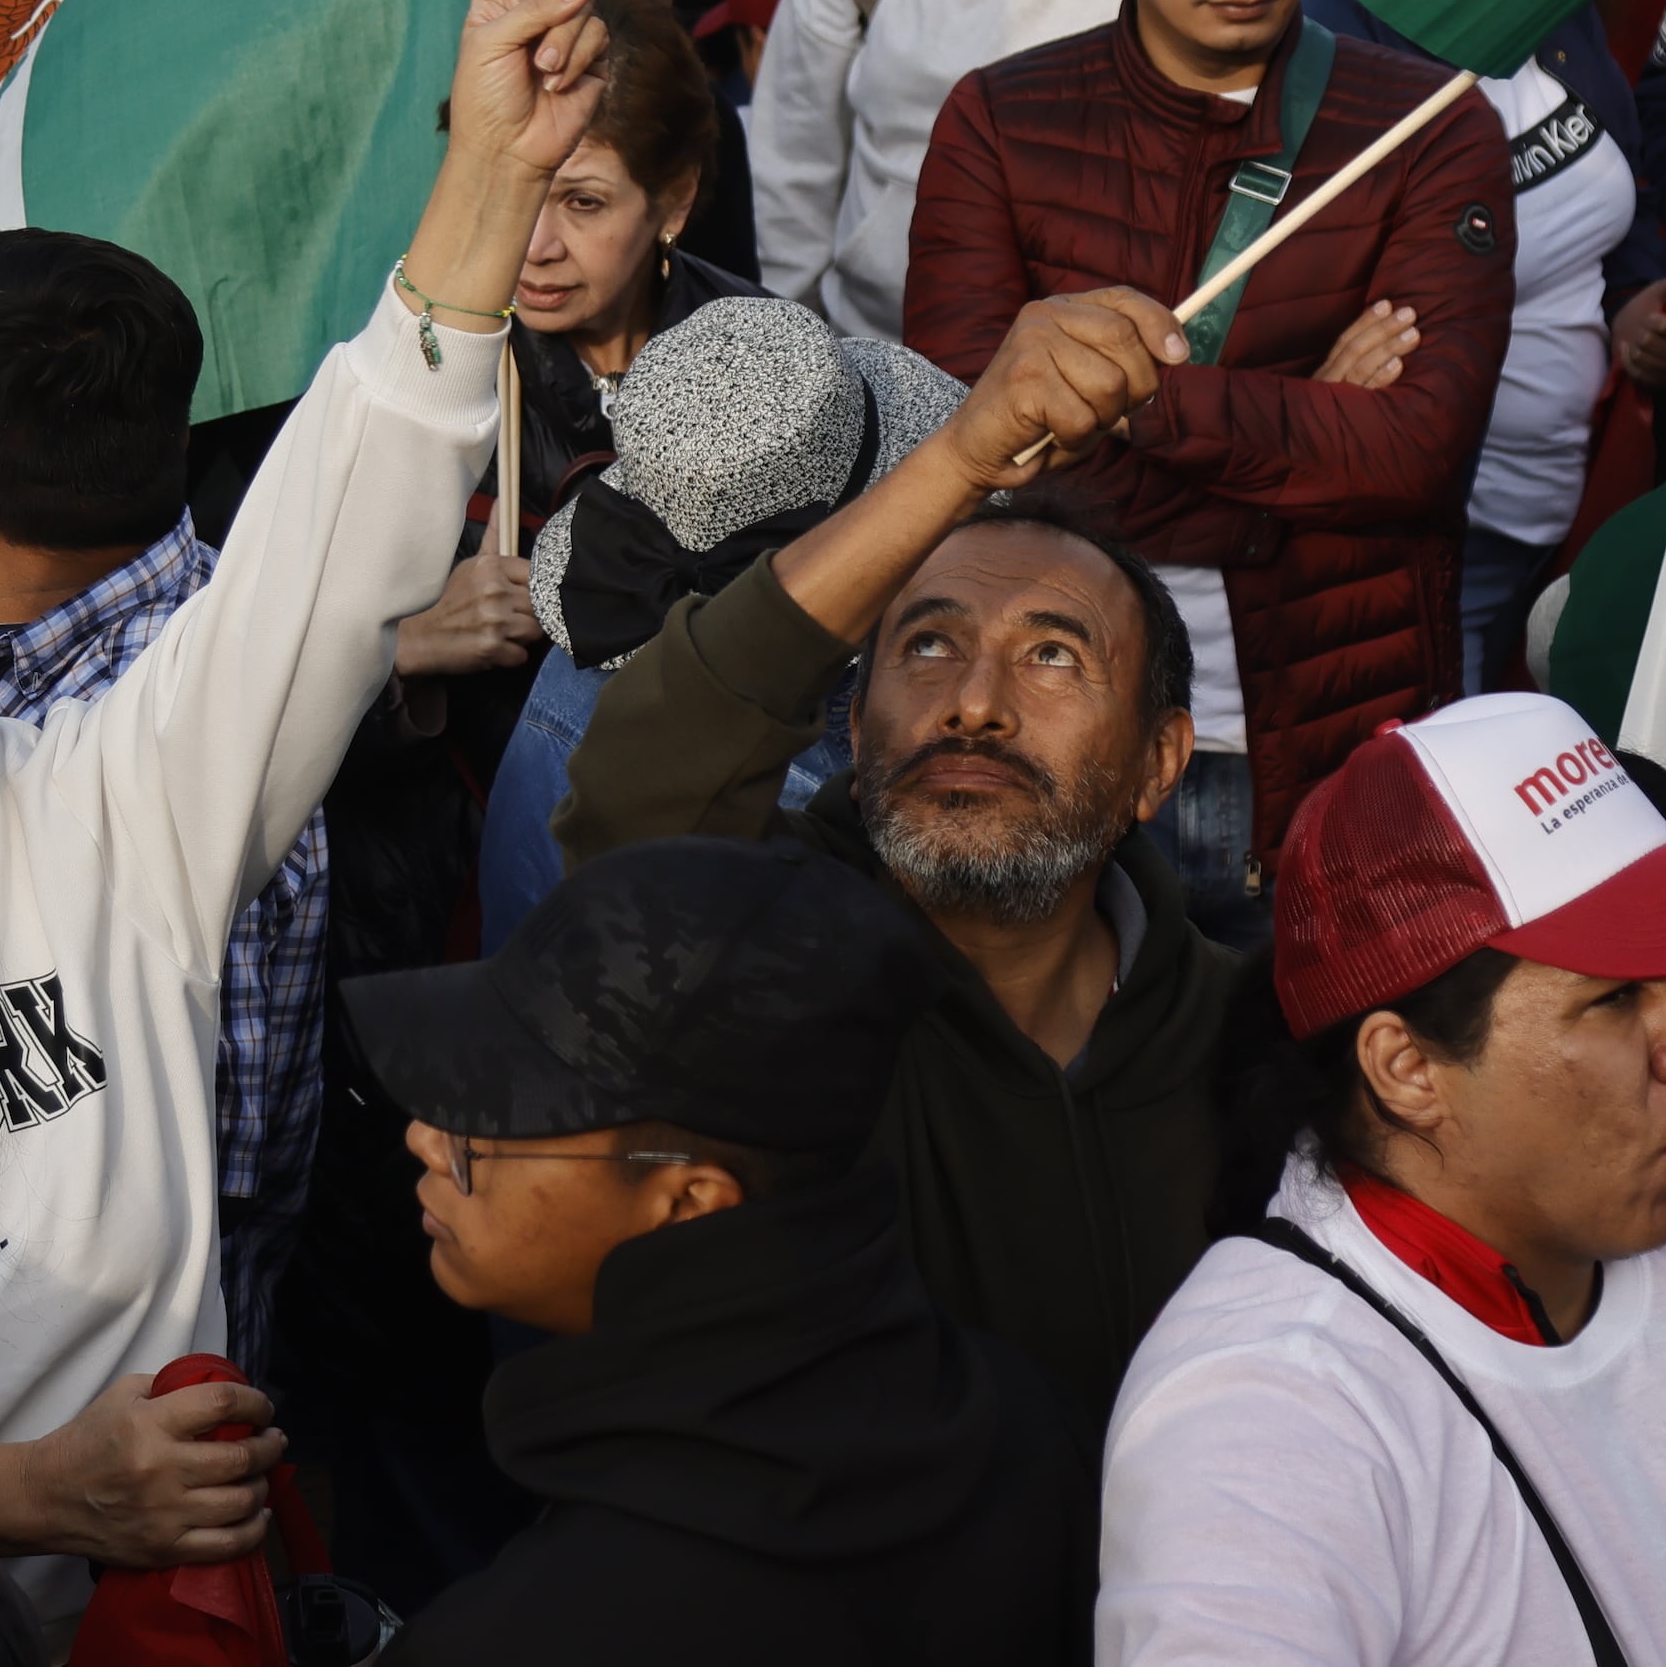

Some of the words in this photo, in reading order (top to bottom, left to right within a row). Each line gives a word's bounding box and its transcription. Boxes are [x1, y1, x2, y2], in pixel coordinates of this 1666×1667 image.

[1513, 737, 1621, 817] more
[1540, 817, 1562, 835] La
[1562, 778, 1620, 820] esperanza
